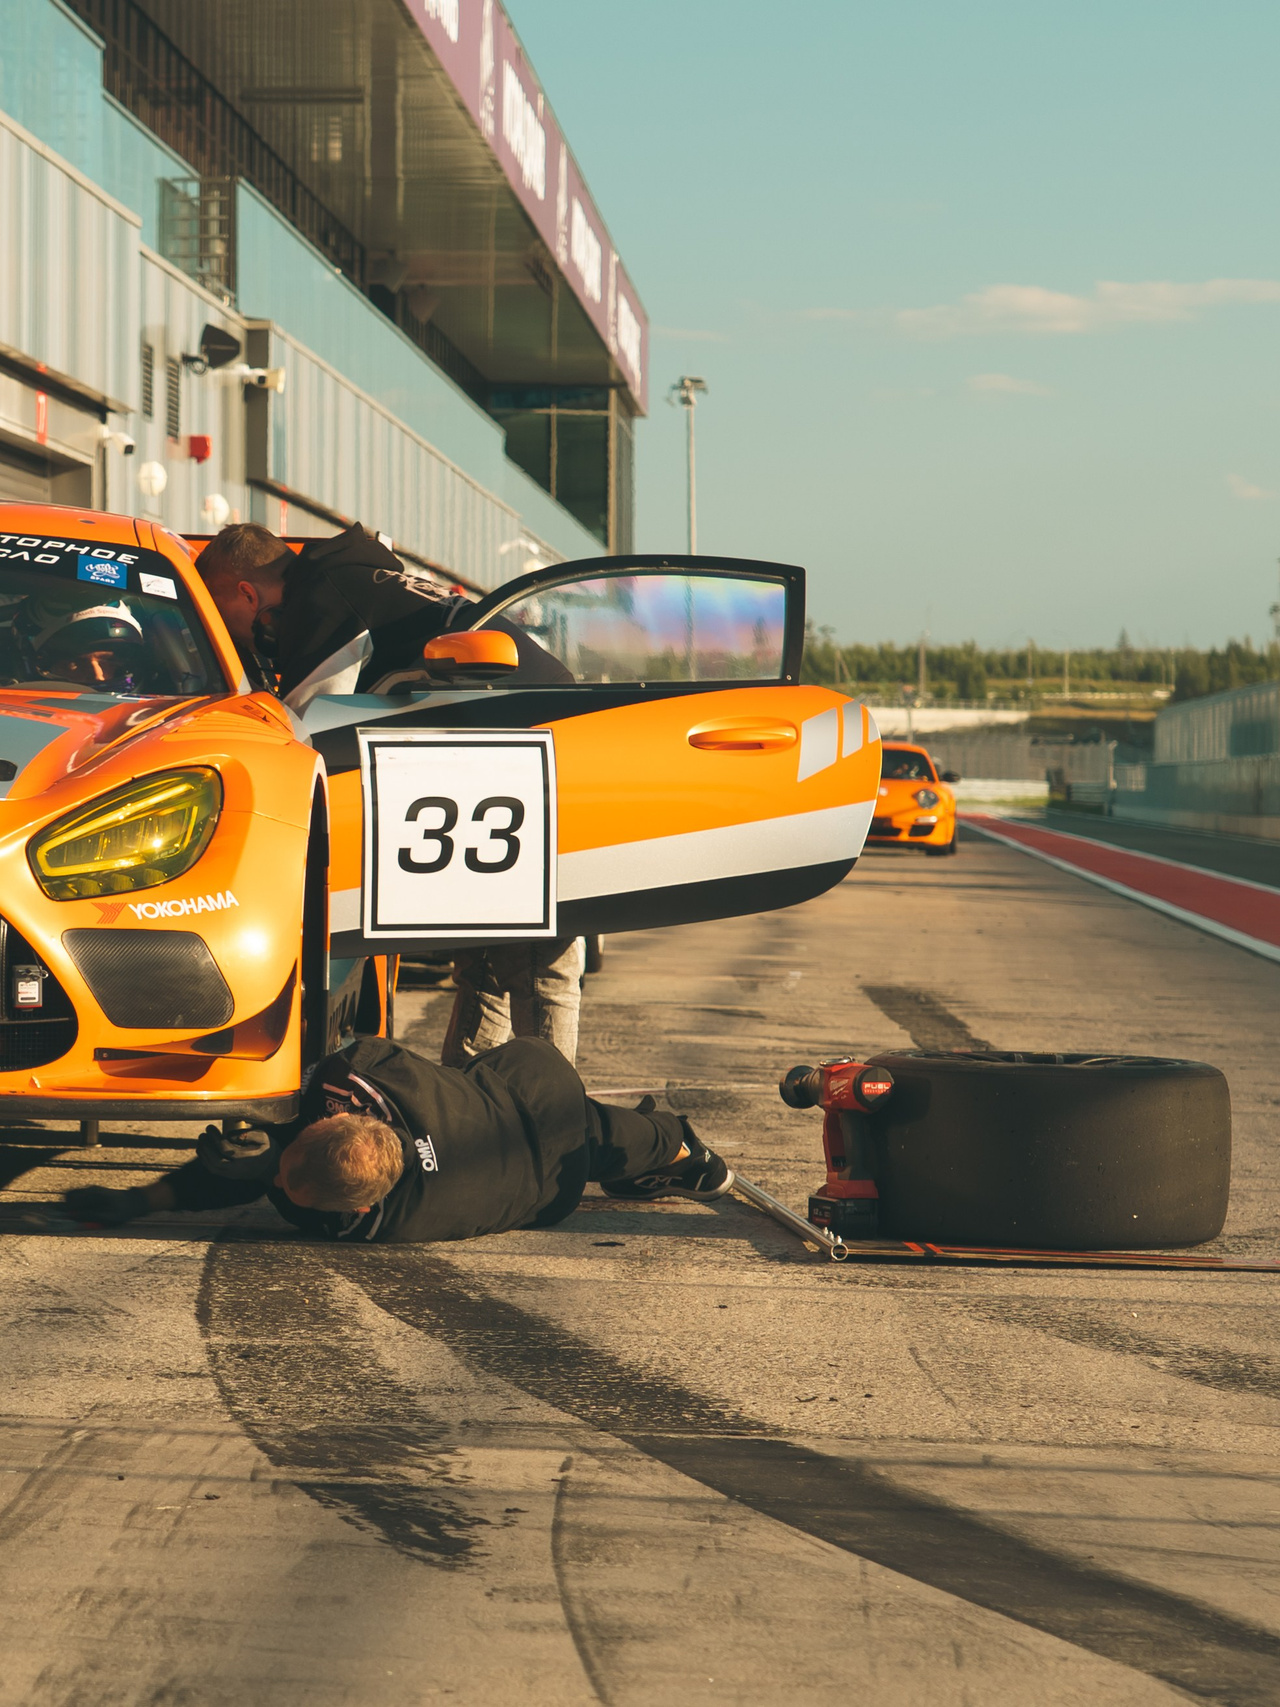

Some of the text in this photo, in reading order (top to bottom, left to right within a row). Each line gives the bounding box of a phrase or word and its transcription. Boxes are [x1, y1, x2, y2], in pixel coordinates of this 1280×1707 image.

[397, 796, 525, 874] 33
[128, 890, 240, 920] YOKOHAMA
[415, 1138, 436, 1172] OMP
